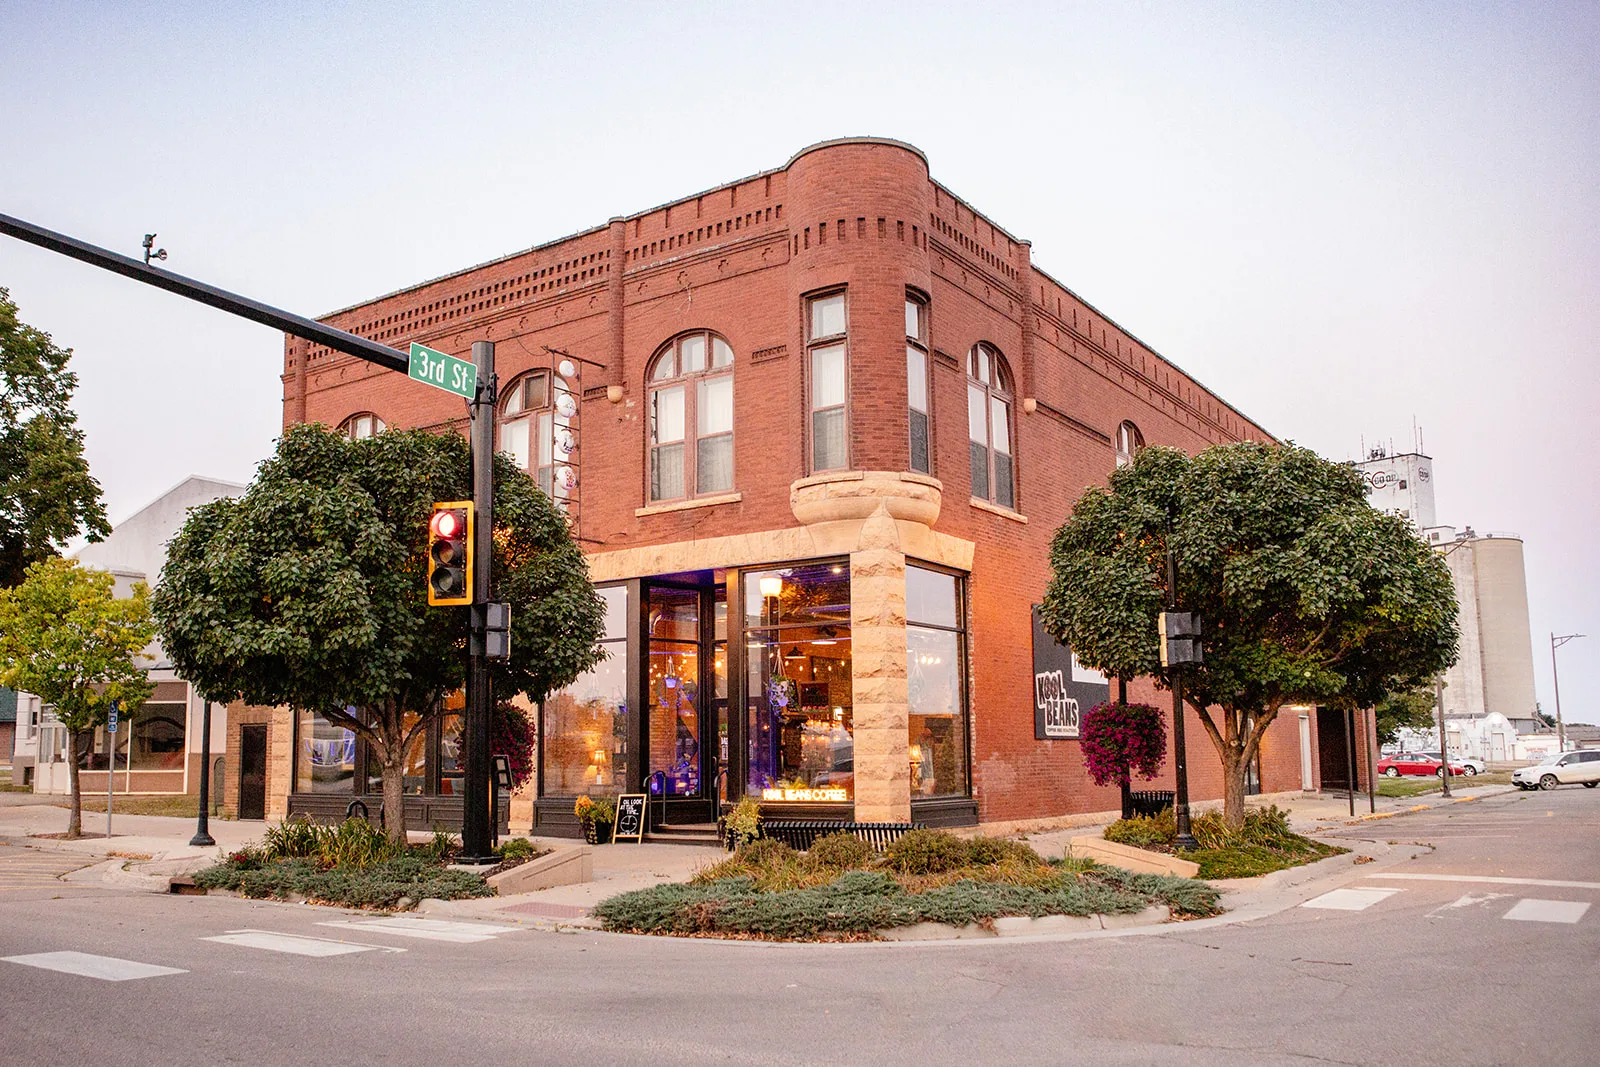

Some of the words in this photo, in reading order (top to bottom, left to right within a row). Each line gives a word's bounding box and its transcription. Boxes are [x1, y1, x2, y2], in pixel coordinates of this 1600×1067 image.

[418, 351, 445, 384] 3rd
[451, 363, 468, 392] St
[1037, 672, 1065, 706] KOOL
[1046, 700, 1077, 727] BEANS
[812, 789, 846, 801] COFFEE
